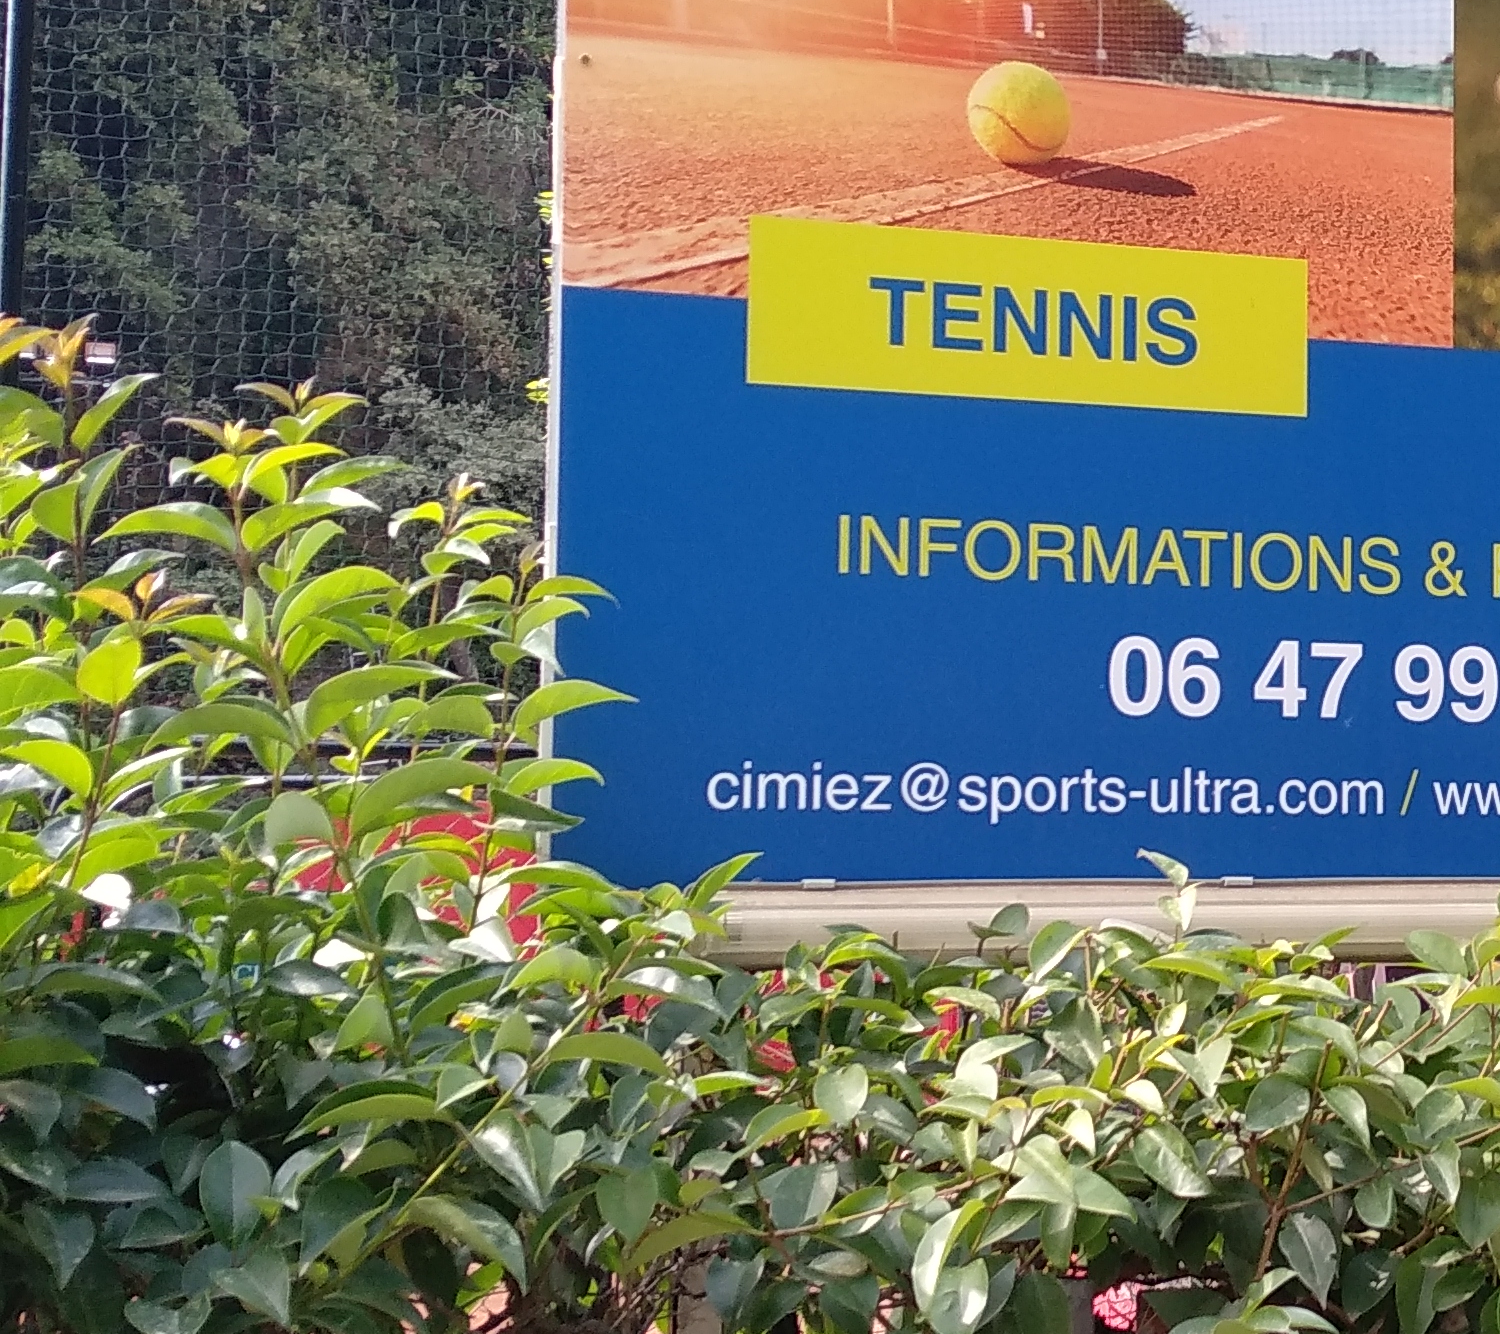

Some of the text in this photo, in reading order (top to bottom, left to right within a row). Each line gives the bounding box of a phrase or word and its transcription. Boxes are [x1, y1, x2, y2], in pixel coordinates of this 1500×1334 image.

[869, 276, 1198, 366] TENNIS
[838, 514, 1401, 595] INFORMATIONS
[1424, 541, 1467, 597] &
[1107, 634, 1221, 718] 06
[1252, 640, 1364, 719] 47
[1393, 644, 1499, 723] 99
[706, 760, 1385, 825] cimiez@sports-ultra.com
